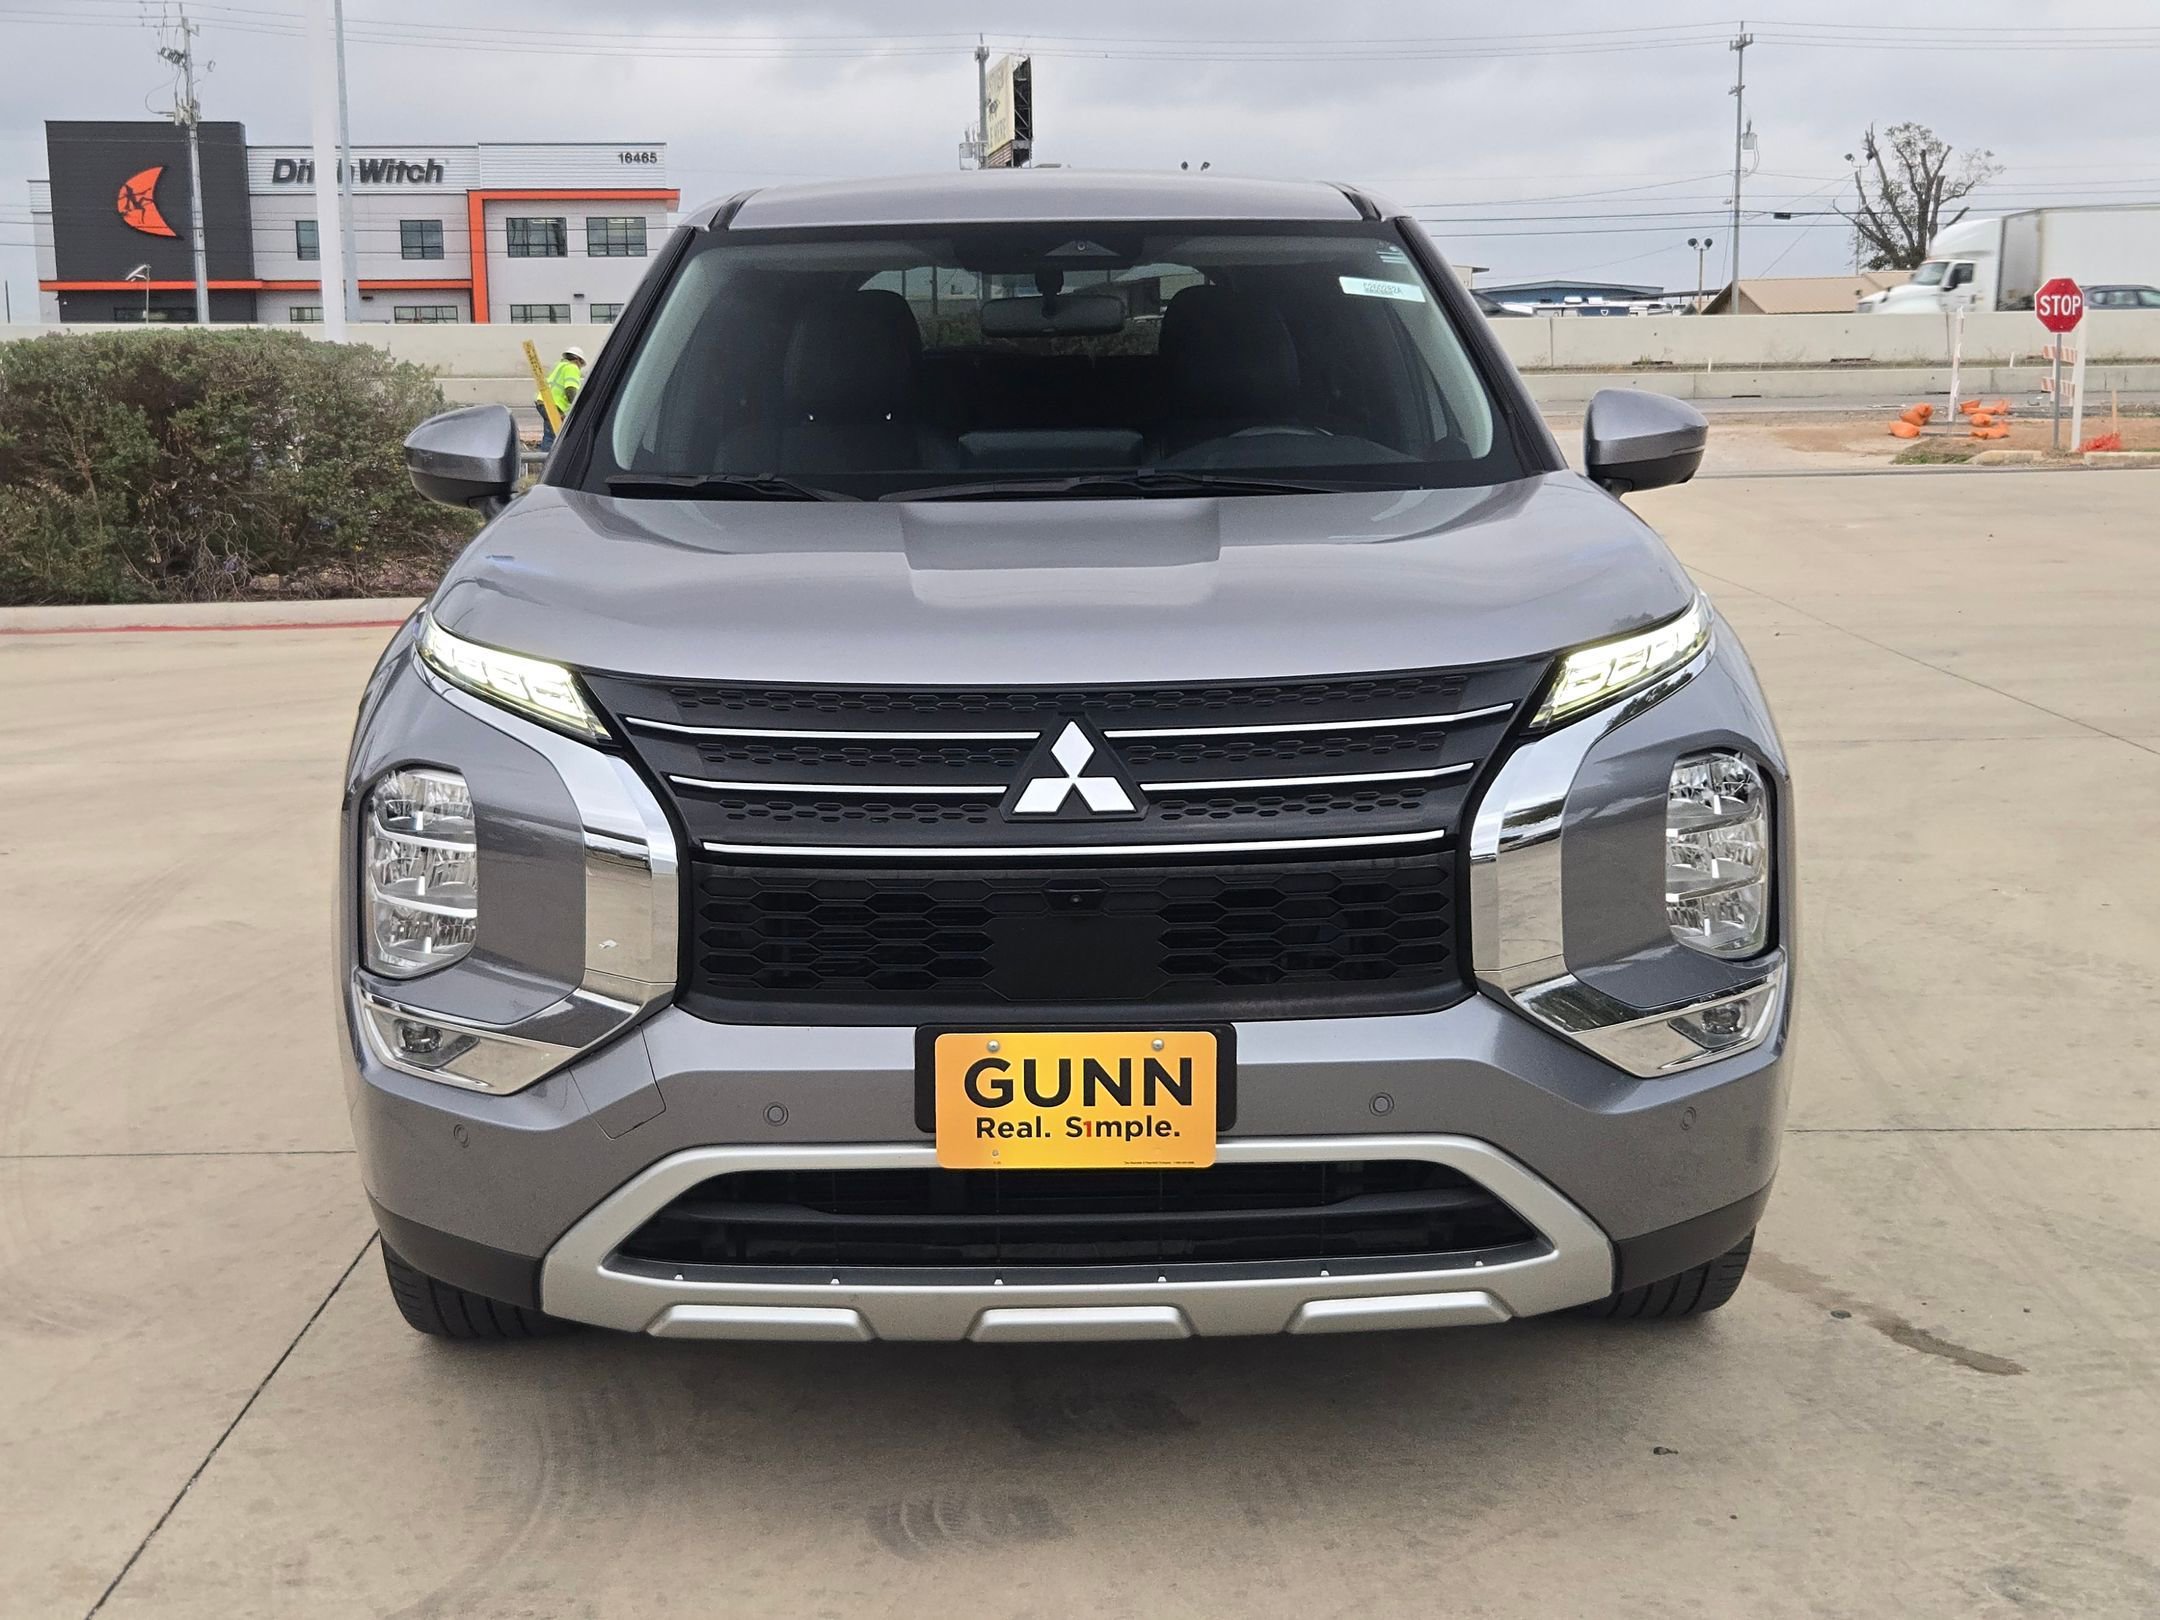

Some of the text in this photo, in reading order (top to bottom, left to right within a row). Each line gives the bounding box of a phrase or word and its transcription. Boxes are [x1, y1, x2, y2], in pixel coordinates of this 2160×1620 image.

[359, 158, 444, 184] Witch
[2039, 295, 2081, 316] STOP
[964, 1057, 1193, 1108] GUNN
[976, 1115, 1051, 1139] Real.
